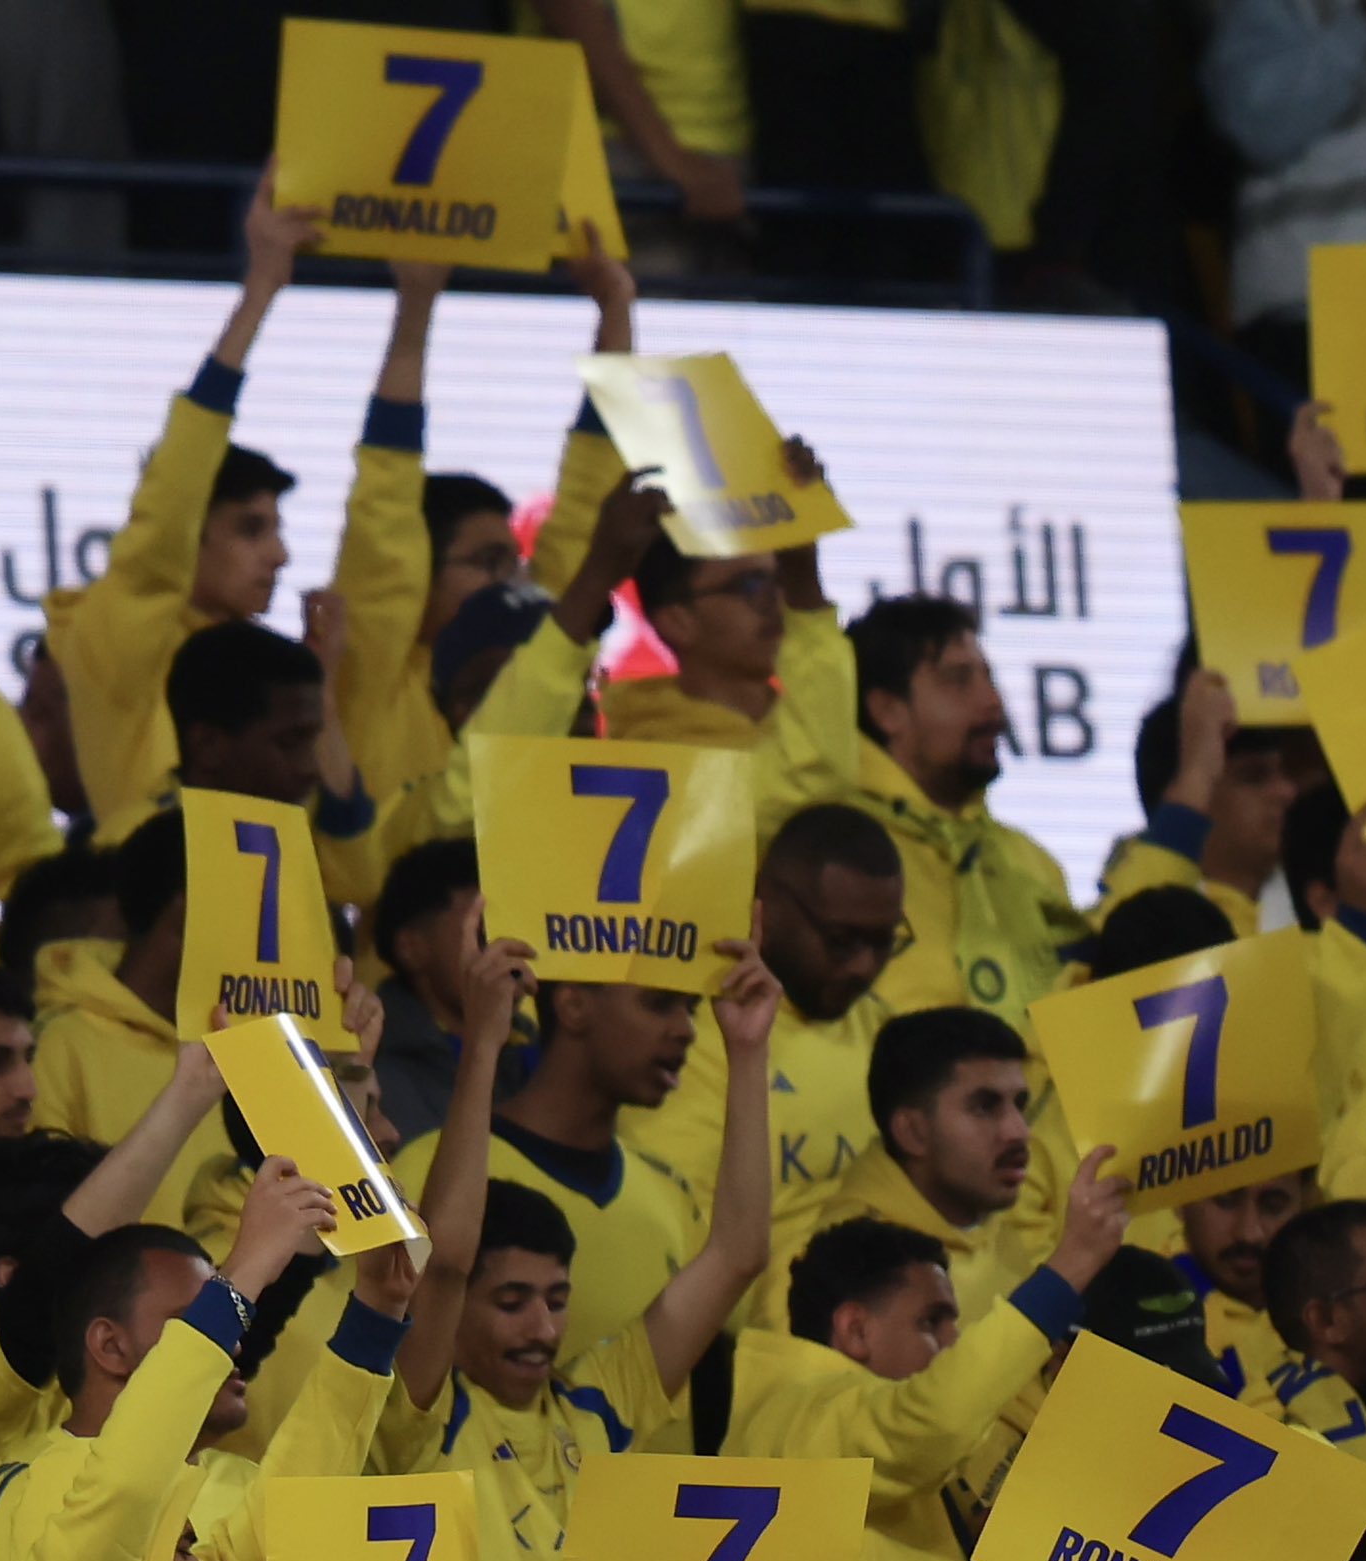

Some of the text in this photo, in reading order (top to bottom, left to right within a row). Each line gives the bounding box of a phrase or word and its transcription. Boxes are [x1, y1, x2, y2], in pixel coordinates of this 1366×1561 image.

[387, 56, 483, 185] 7
[330, 195, 495, 240] RONALDO
[1269, 530, 1352, 649] 7
[237, 822, 280, 962] 7
[573, 766, 671, 904] 7
[219, 975, 320, 1020] RONALDO
[549, 916, 695, 956] RONALDO
[1135, 976, 1228, 1129] 7
[1139, 1117, 1272, 1192] RONALDO
[1128, 1405, 1279, 1557] 7
